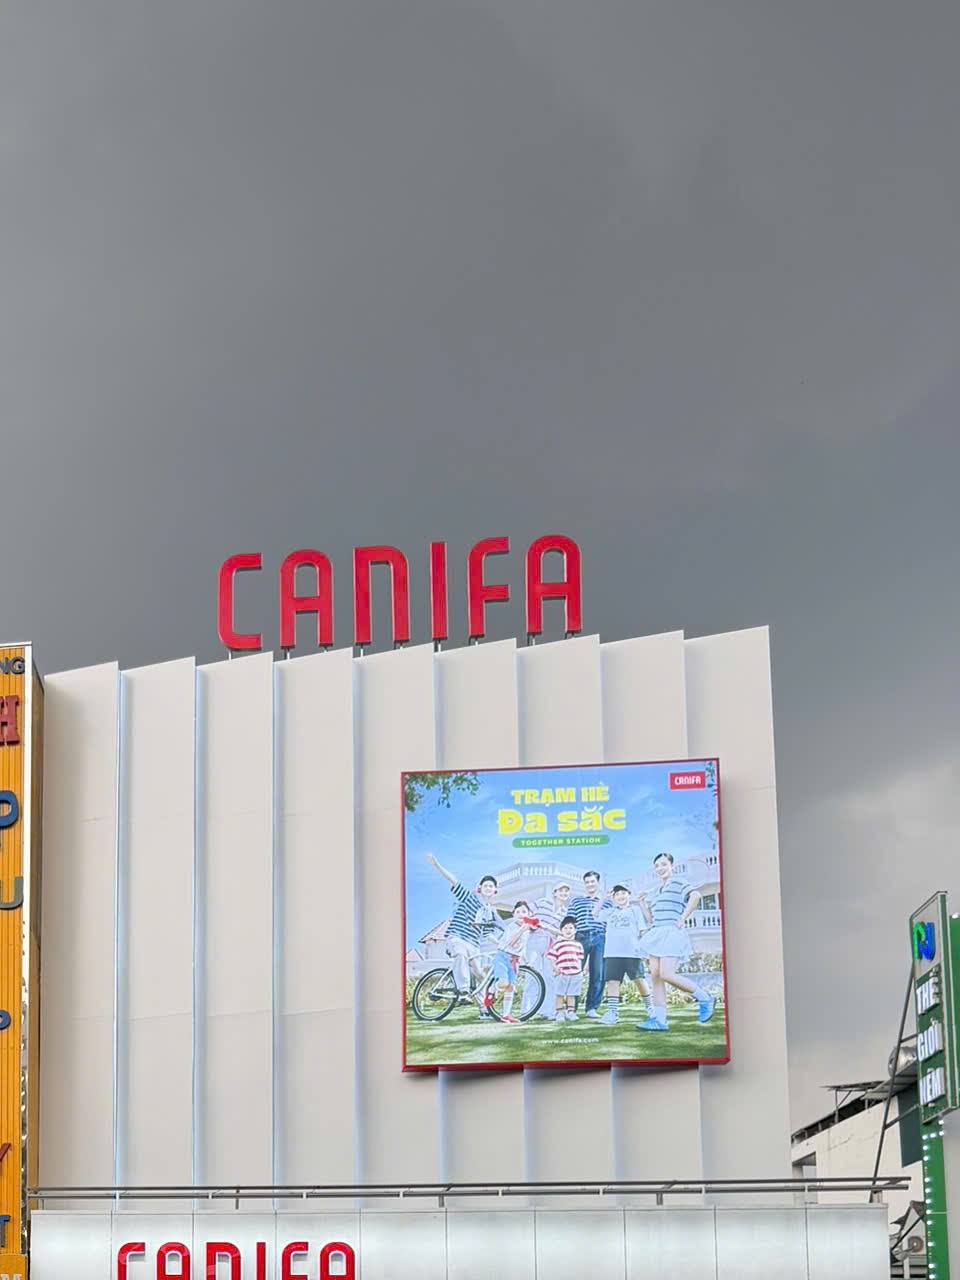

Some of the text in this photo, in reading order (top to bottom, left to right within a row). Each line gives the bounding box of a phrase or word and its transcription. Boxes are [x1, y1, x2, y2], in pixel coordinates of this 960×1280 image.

[218, 534, 582, 651] CANIFA
[674, 775, 702, 786] CANIFA
[510, 781, 610, 807] TRẠM HÈ
[520, 836, 601, 847] TOGETHER STATION
[916, 967, 940, 1015] THẾ
